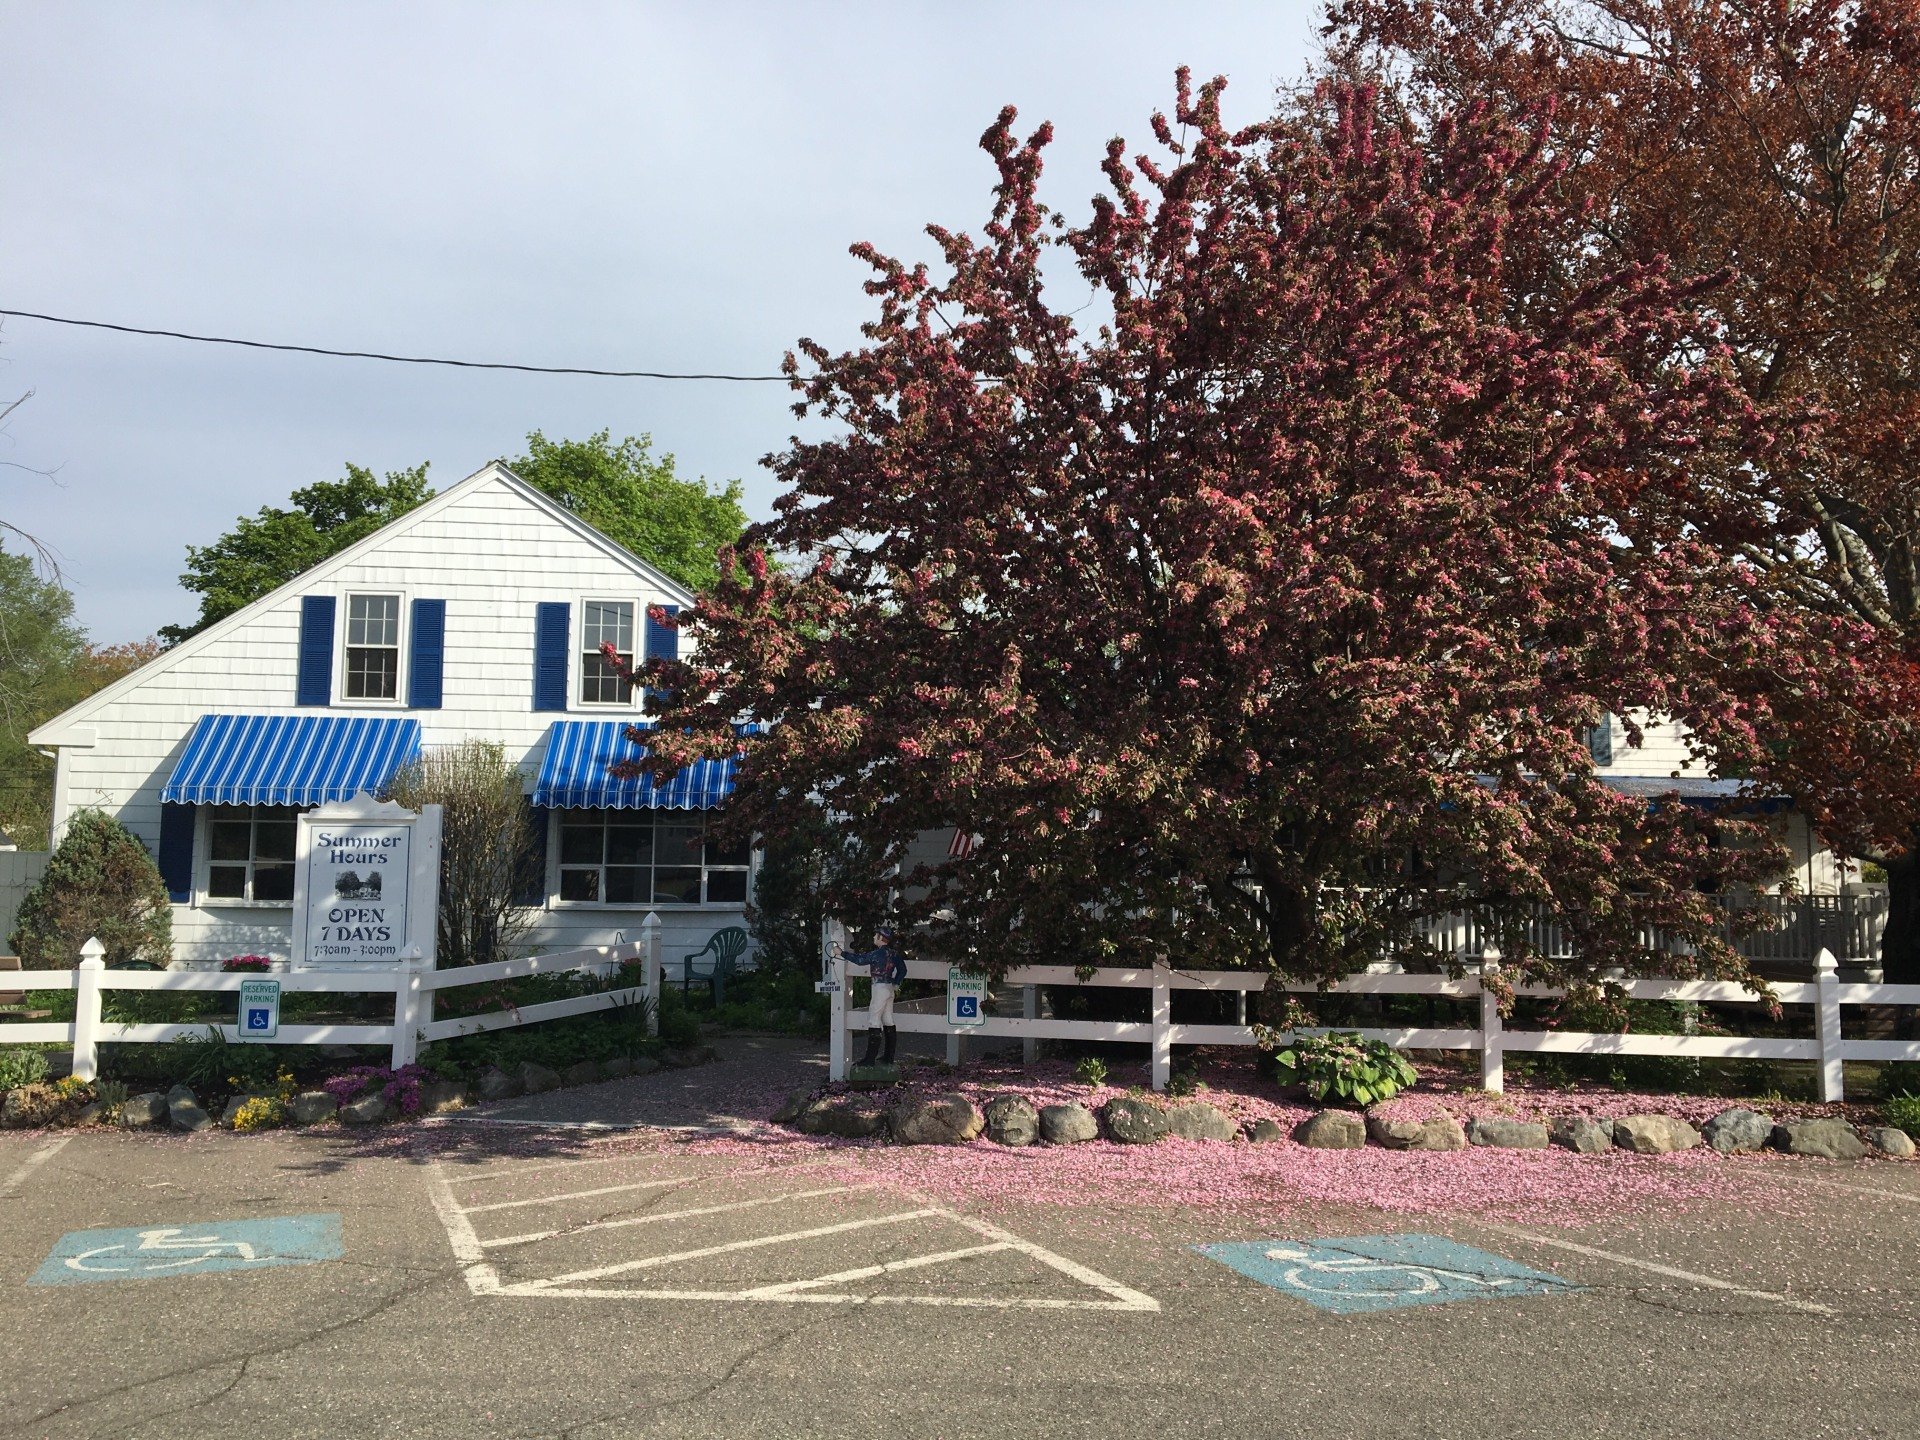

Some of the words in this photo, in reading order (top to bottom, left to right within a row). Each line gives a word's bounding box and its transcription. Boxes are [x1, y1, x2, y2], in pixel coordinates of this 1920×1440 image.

[317, 832, 402, 849] Summer
[330, 849, 388, 864] Hours
[328, 908, 386, 922] OPEN
[322, 926, 331, 941] 7
[336, 926, 391, 941] DAYS
[314, 945, 351, 957] 7:30am
[243, 985, 277, 993] RESERVED
[952, 982, 982, 990] PARKING
